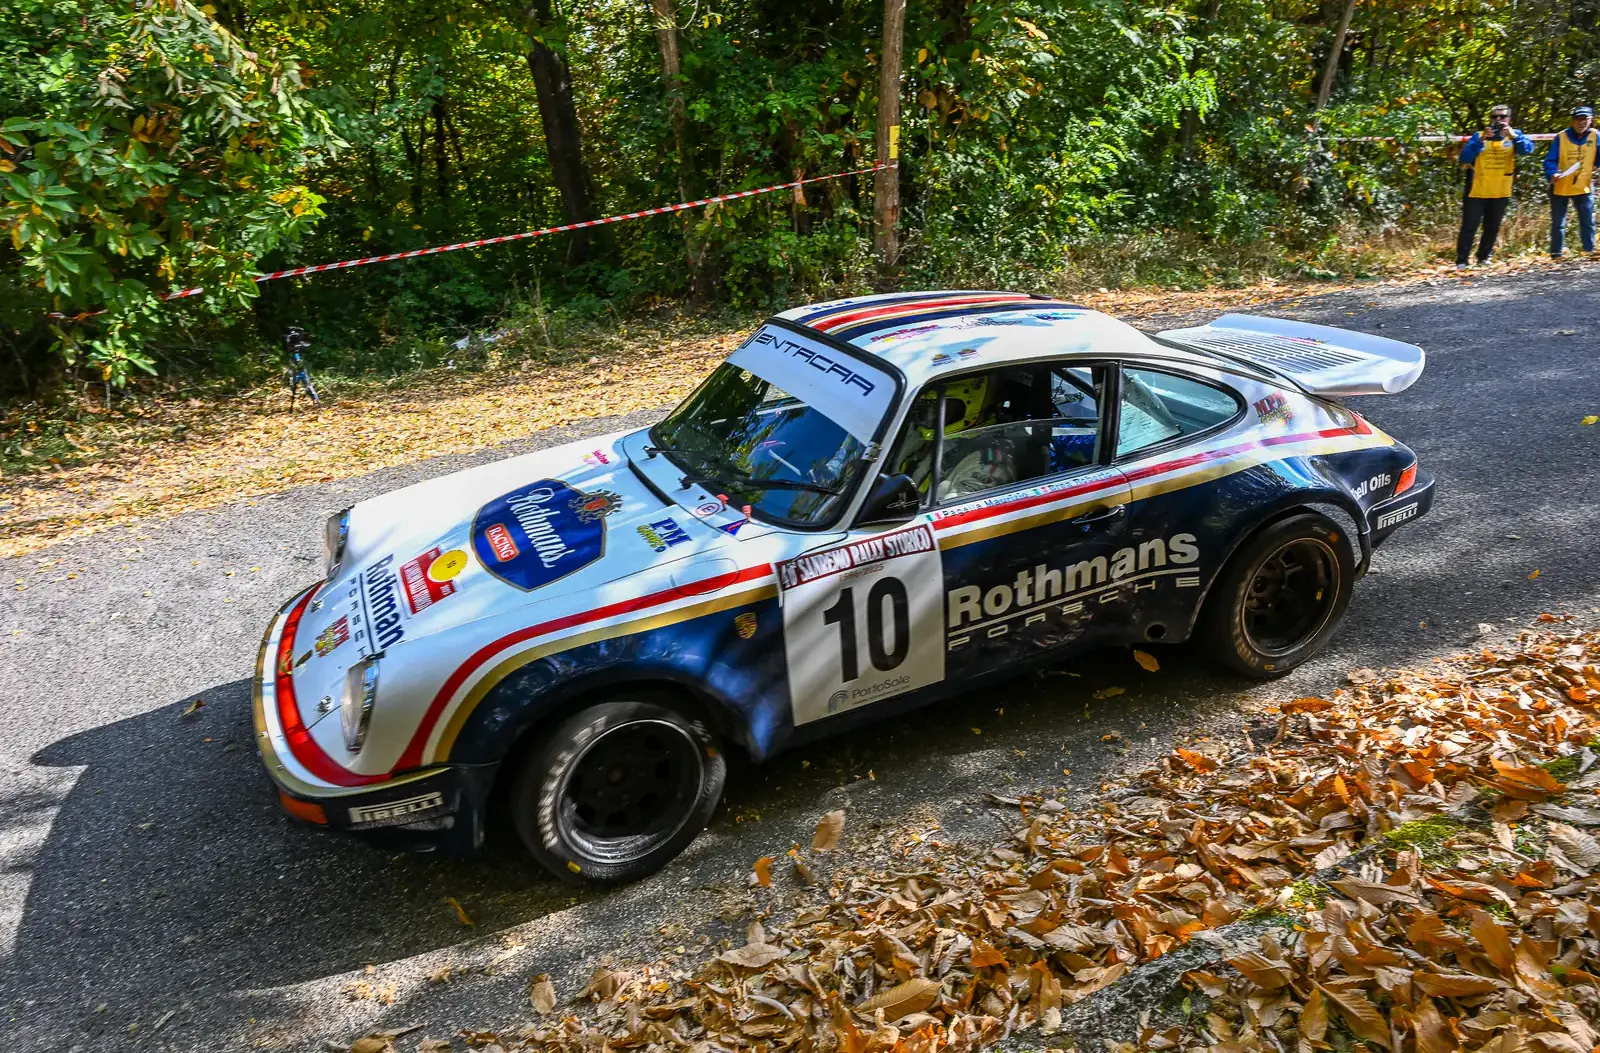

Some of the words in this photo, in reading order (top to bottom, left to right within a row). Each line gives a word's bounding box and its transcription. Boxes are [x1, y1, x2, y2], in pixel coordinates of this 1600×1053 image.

[1072, 470, 1113, 488] Roberto
[1369, 472, 1392, 492] Oils
[983, 491, 1029, 509] Maurizio
[1376, 501, 1419, 530] PIRELLI
[488, 526, 515, 559] RACING
[505, 487, 576, 569] Rothmans
[649, 517, 693, 548] PM
[797, 547, 852, 580] SANREMO
[849, 539, 886, 564] RALLY
[883, 526, 933, 557] STORICO
[947, 532, 1200, 628] Rothmans
[947, 576, 1200, 651] PORSCHE
[823, 576, 911, 684] 10
[851, 674, 912, 700] PortoSole
[347, 791, 445, 823] PIRELLI
